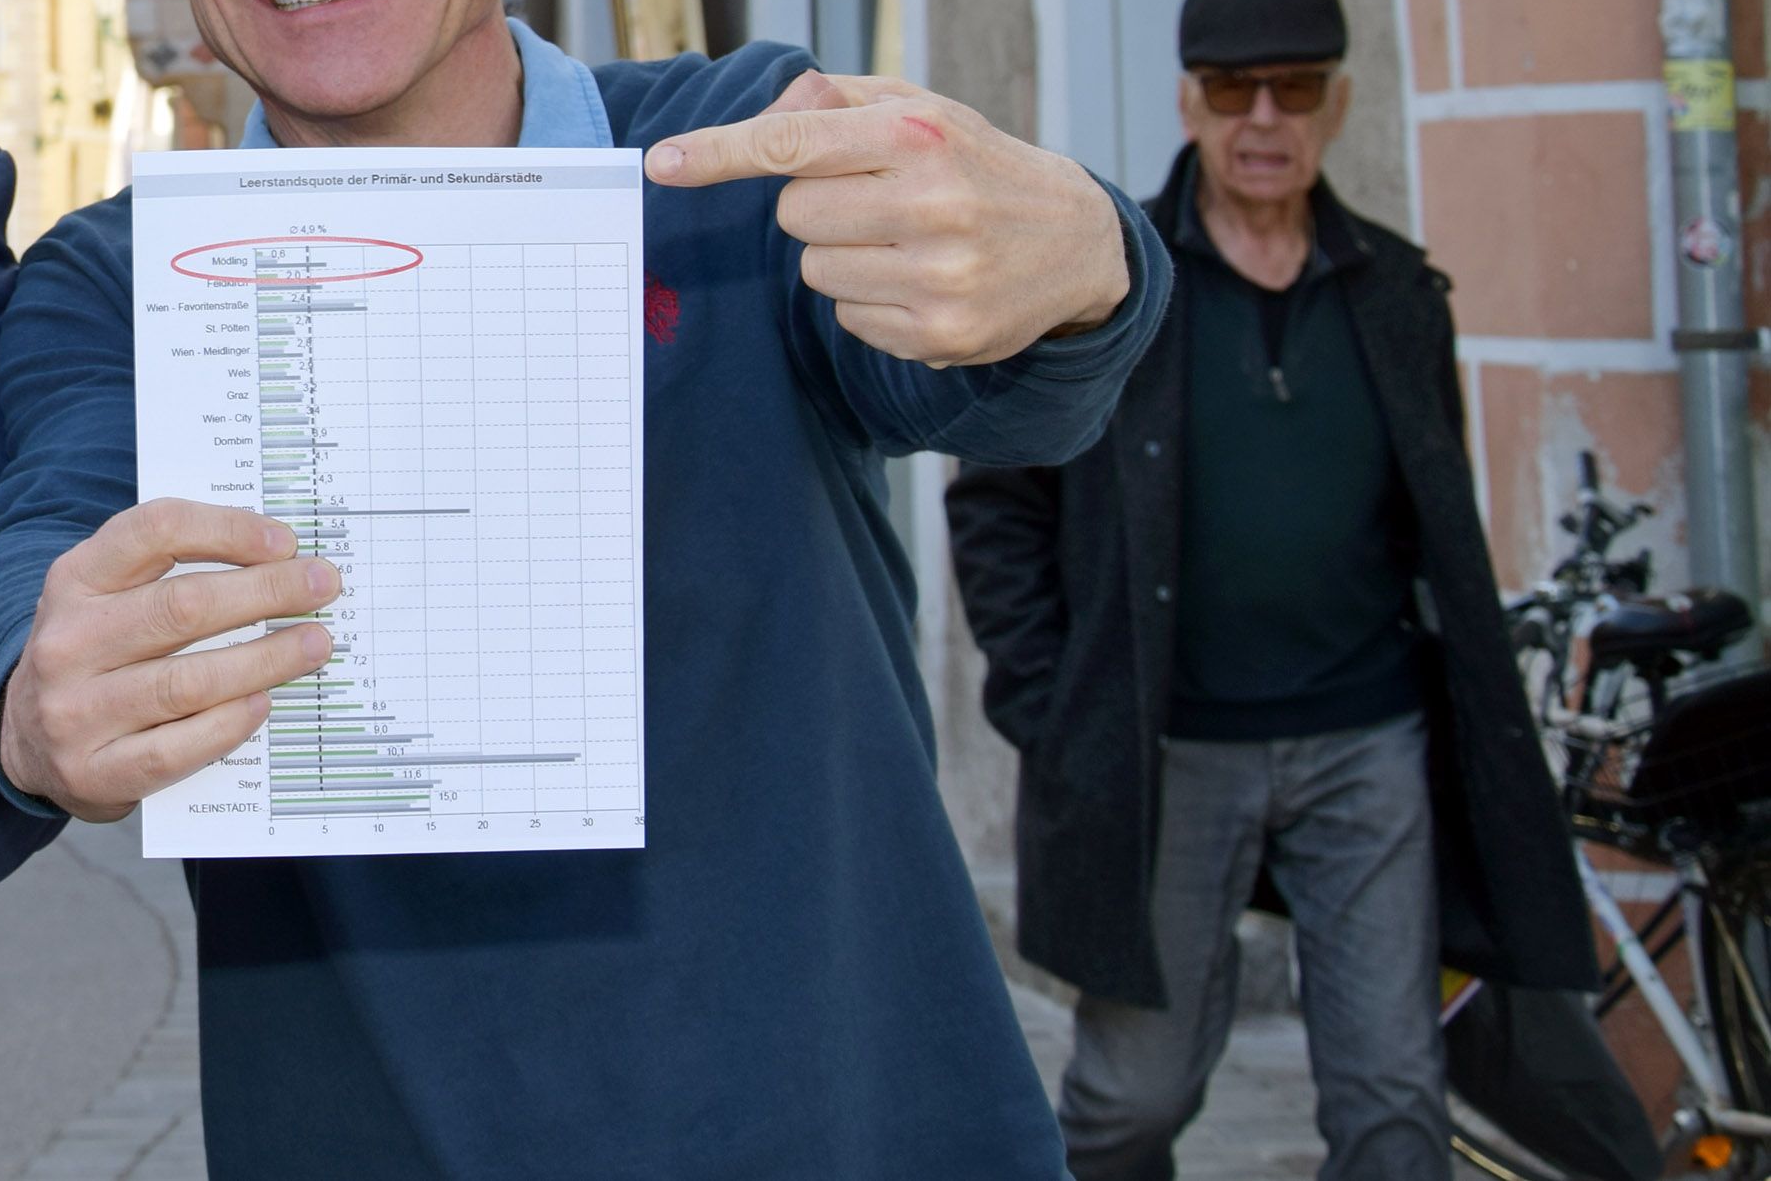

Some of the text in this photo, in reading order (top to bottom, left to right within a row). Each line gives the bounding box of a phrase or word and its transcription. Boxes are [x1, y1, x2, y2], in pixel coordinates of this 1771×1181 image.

[239, 171, 543, 190] Leerstandsquote der Primär- und Sekundärstädte
[300, 224, 316, 235] 4,9
[317, 224, 327, 234] %
[271, 249, 286, 260] 0,6
[212, 256, 248, 267] Mödling
[286, 270, 301, 280] 20
[291, 293, 306, 304] 2,4
[146, 303, 170, 313] Wien
[178, 300, 249, 312] Favoritenstraße
[205, 323, 250, 333] St. Pölten
[171, 348, 195, 357] Wien
[227, 369, 251, 378] Wels
[226, 391, 249, 400] Graz
[203, 414, 226, 423] Wien
[235, 414, 253, 425] City
[214, 436, 253, 446] Dornbirn
[314, 451, 329, 462] 4,1
[235, 459, 254, 468] Linz
[318, 474, 333, 484] 4,3
[211, 482, 255, 492] Innsbruck
[330, 496, 344, 506] 5,4
[331, 519, 346, 529] 5,4
[335, 541, 349, 551] 5,8
[338, 564, 353, 575] 6,0
[340, 587, 355, 598] 6,2
[341, 610, 356, 621] 6,2
[343, 633, 358, 644] 6,4
[353, 656, 367, 666] 7,2
[362, 679, 377, 689] 8,1
[372, 702, 387, 712] 8,9
[373, 725, 388, 735] 9,0
[387, 747, 405, 757] 10,1
[221, 756, 262, 766] Neustadt
[403, 770, 422, 780] 11,6
[238, 780, 262, 790] Steyr
[439, 792, 458, 802] 15,0
[268, 826, 275, 836] 0
[322, 825, 329, 834] 5
[374, 823, 384, 833] 10
[426, 822, 436, 831] 15
[477, 820, 489, 830] 20
[530, 819, 541, 829] 25
[582, 818, 594, 827] 30
